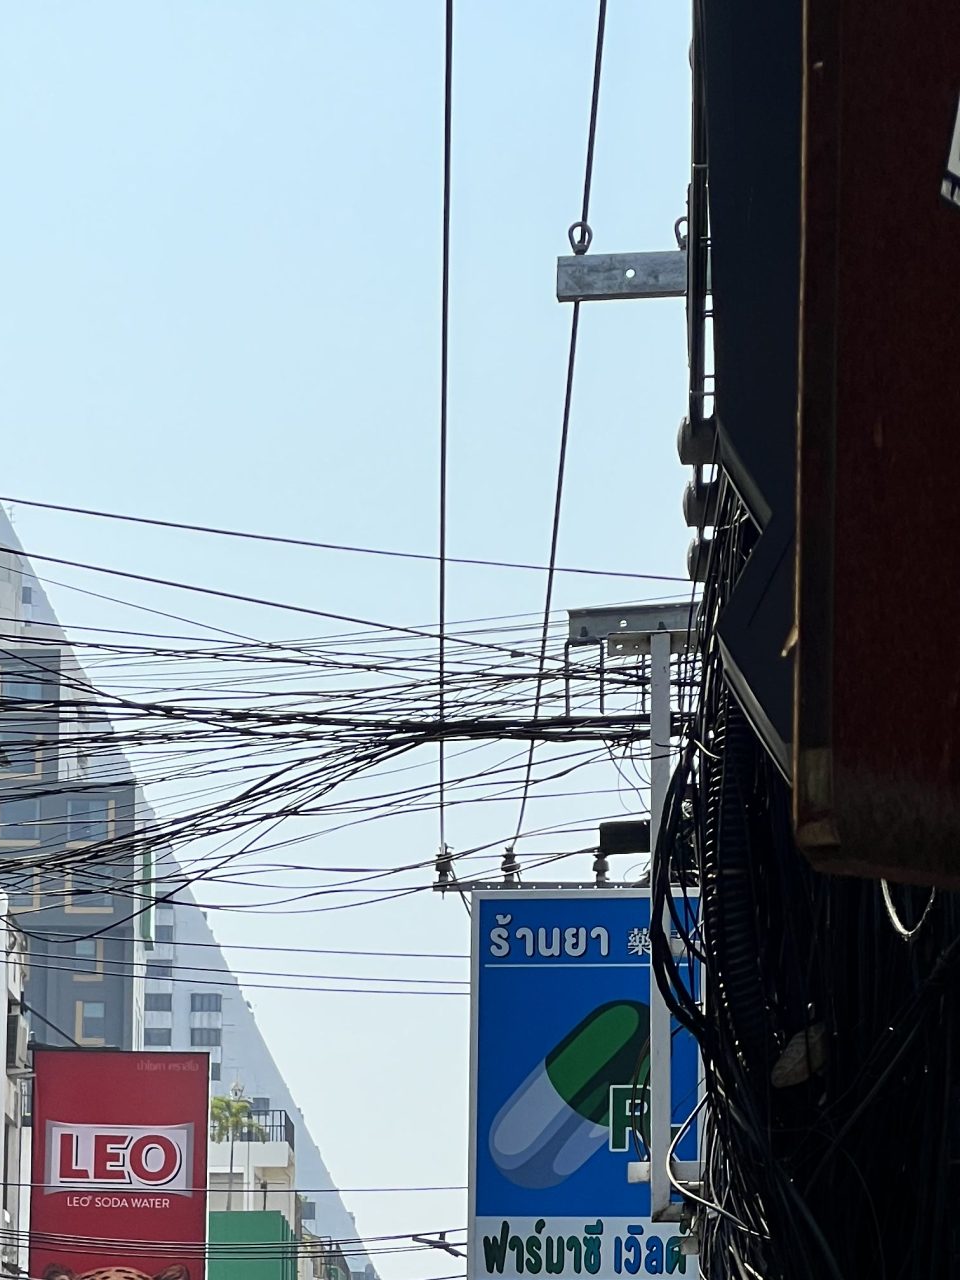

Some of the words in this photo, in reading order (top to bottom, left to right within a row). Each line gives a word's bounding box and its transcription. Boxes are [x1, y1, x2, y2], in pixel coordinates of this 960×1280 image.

[490, 914, 609, 957] ร้านยา
[59, 1133, 183, 1186] LEO
[95, 1197, 129, 1208] SODA
[131, 1198, 170, 1209] WATER
[483, 1219, 603, 1275] ฟาร์มาซี
